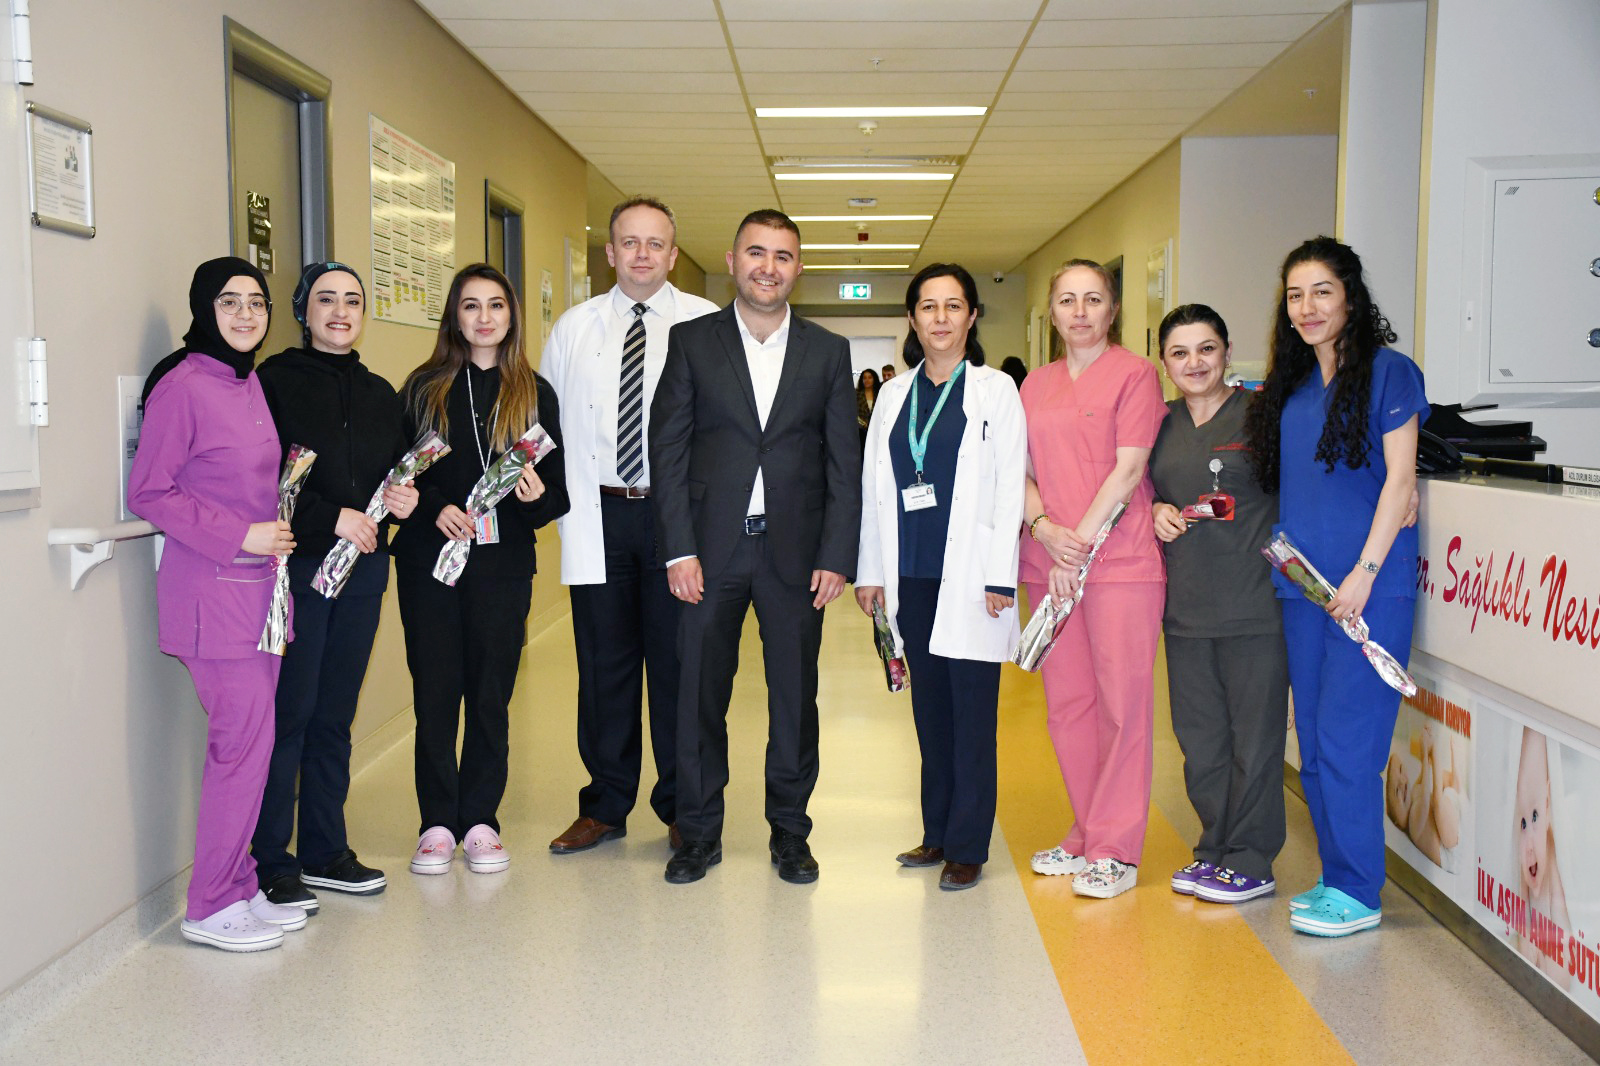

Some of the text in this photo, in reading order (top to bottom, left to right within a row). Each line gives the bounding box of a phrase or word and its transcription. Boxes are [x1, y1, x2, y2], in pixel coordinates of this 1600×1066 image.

[1443, 535, 1531, 634] Sağlıklı
[1477, 856, 1495, 913] İLK
[1497, 882, 1526, 936] AŞIM
[1529, 907, 1564, 968] ANNE
